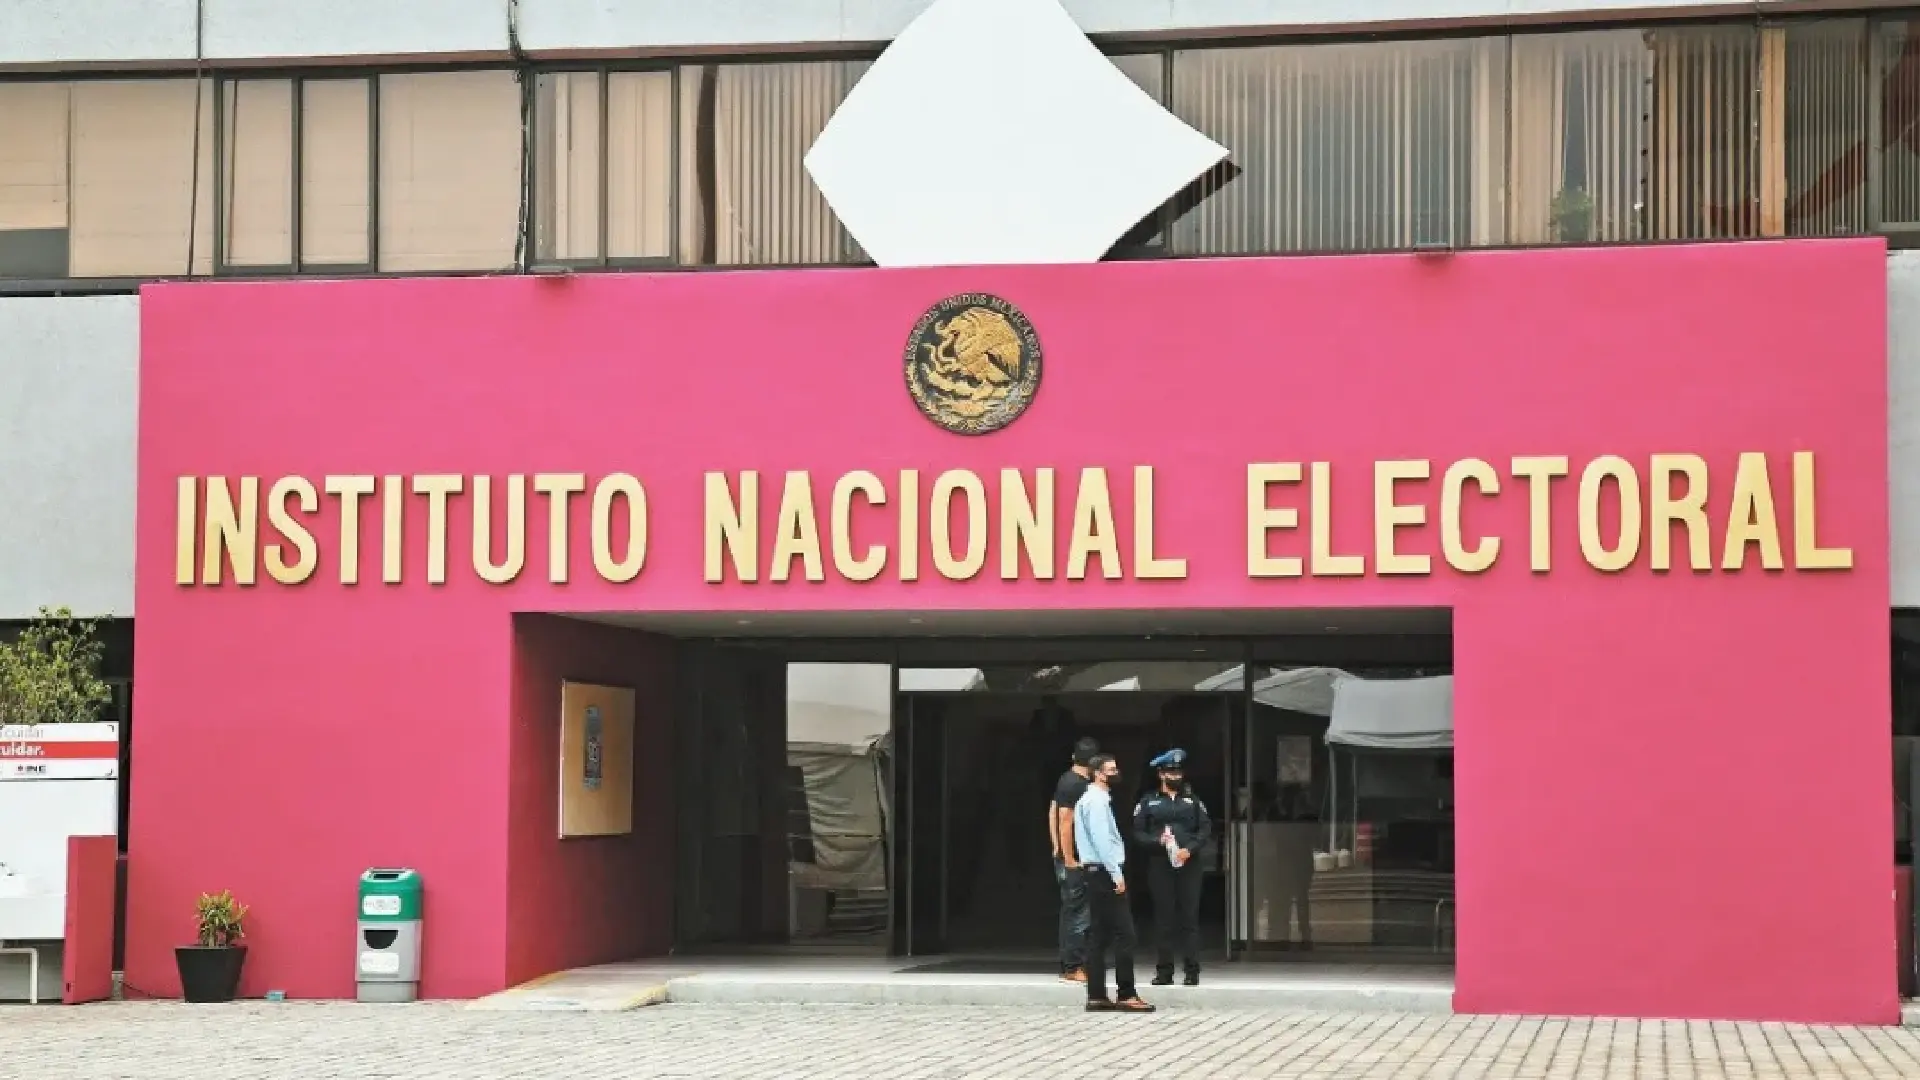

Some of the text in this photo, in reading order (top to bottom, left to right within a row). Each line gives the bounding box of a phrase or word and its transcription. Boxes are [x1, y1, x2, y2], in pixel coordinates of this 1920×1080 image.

[941, 294, 987, 311] UNIDOS
[176, 452, 1853, 585] INSTITUTO NACIONAL ELECTORAL
